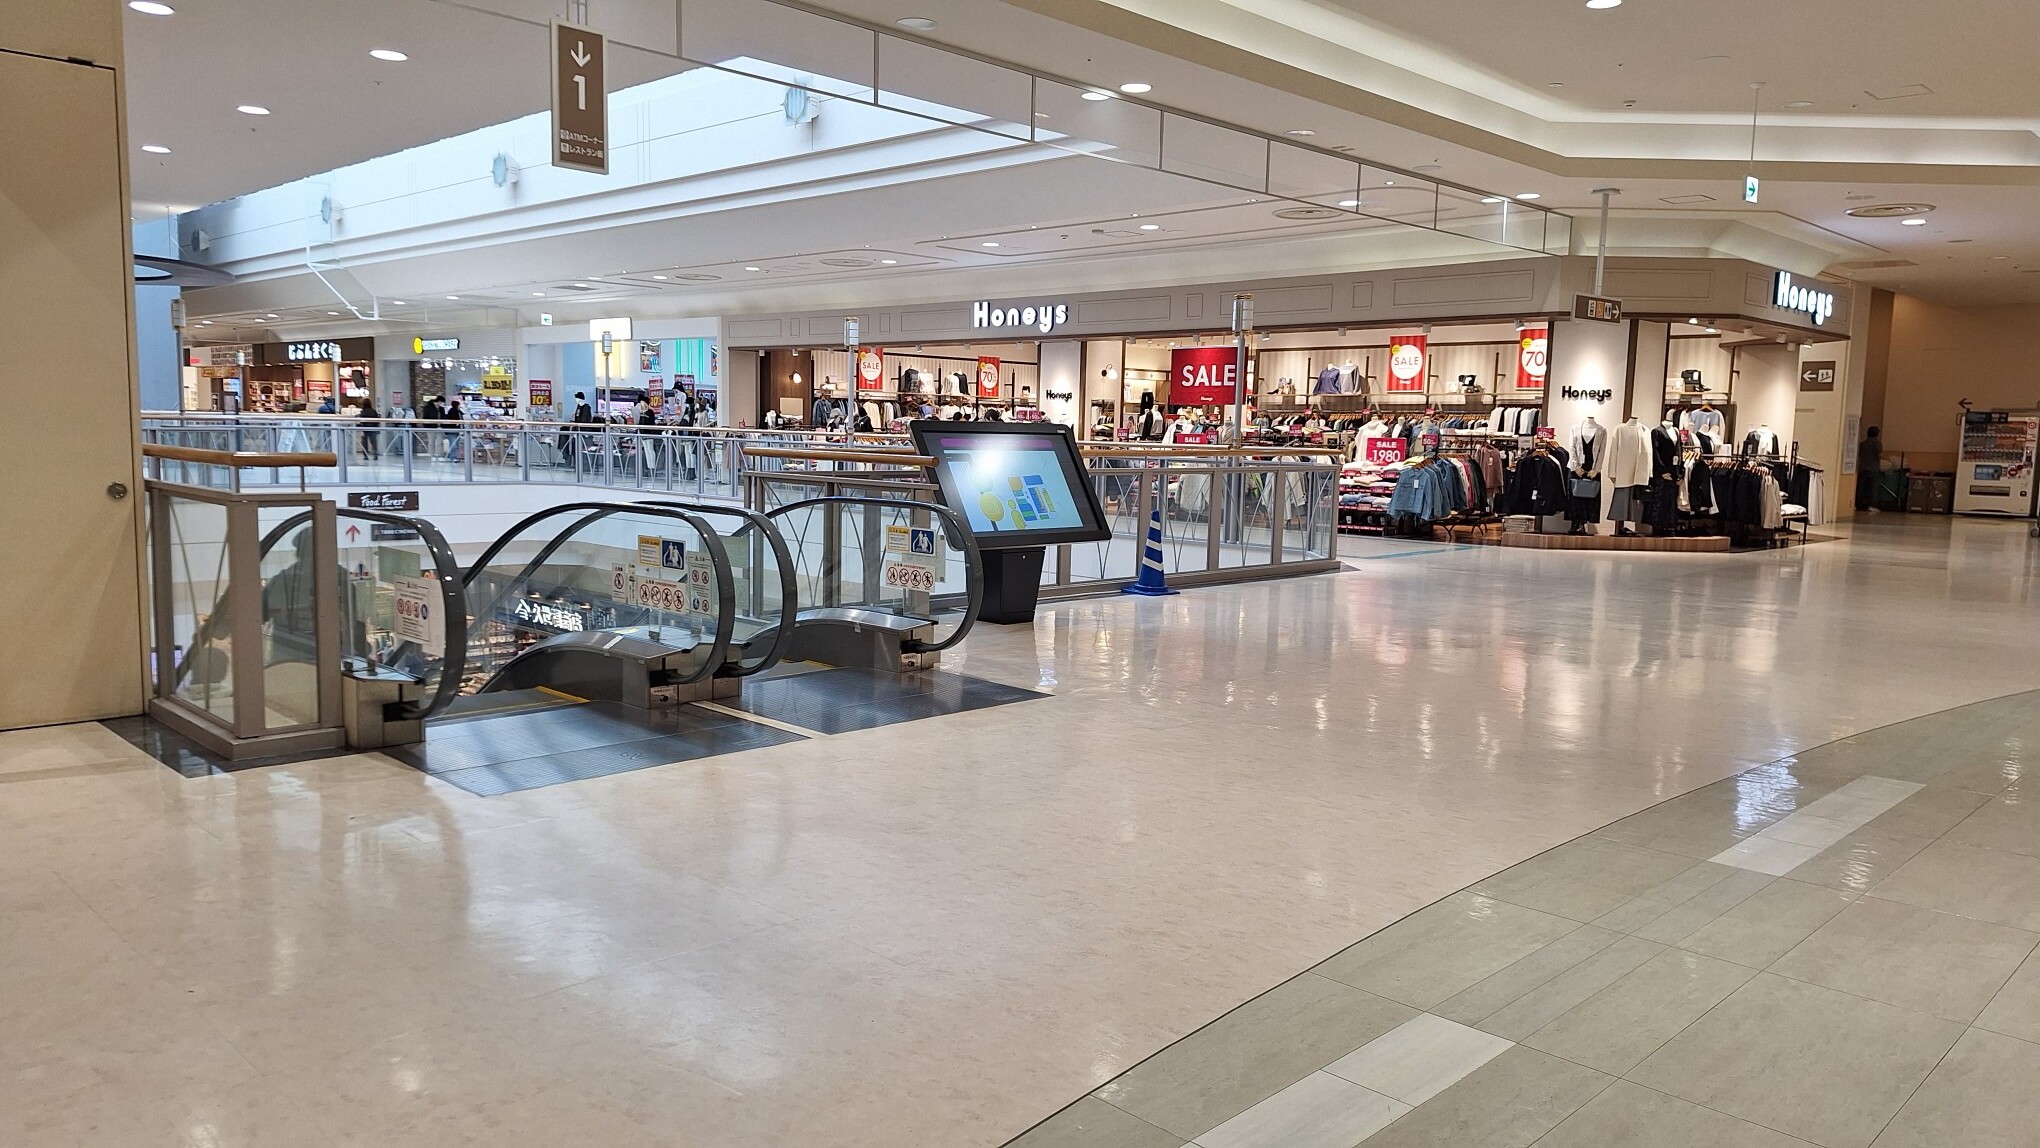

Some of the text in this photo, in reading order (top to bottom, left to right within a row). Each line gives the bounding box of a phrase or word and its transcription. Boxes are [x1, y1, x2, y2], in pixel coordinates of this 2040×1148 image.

[572, 74, 586, 111] 1
[569, 132, 604, 145] ATMコーナー
[1777, 271, 1834, 326] Honeys
[973, 301, 1069, 333] Honeys
[862, 361, 880, 370] SALE
[1394, 356, 1420, 366] SALE
[1525, 350, 1545, 367] 70
[1181, 364, 1236, 387] SALE
[1046, 389, 1073, 404] Honeys
[1561, 385, 1612, 402] Honeys
[360, 494, 407, 507] Food Forest
